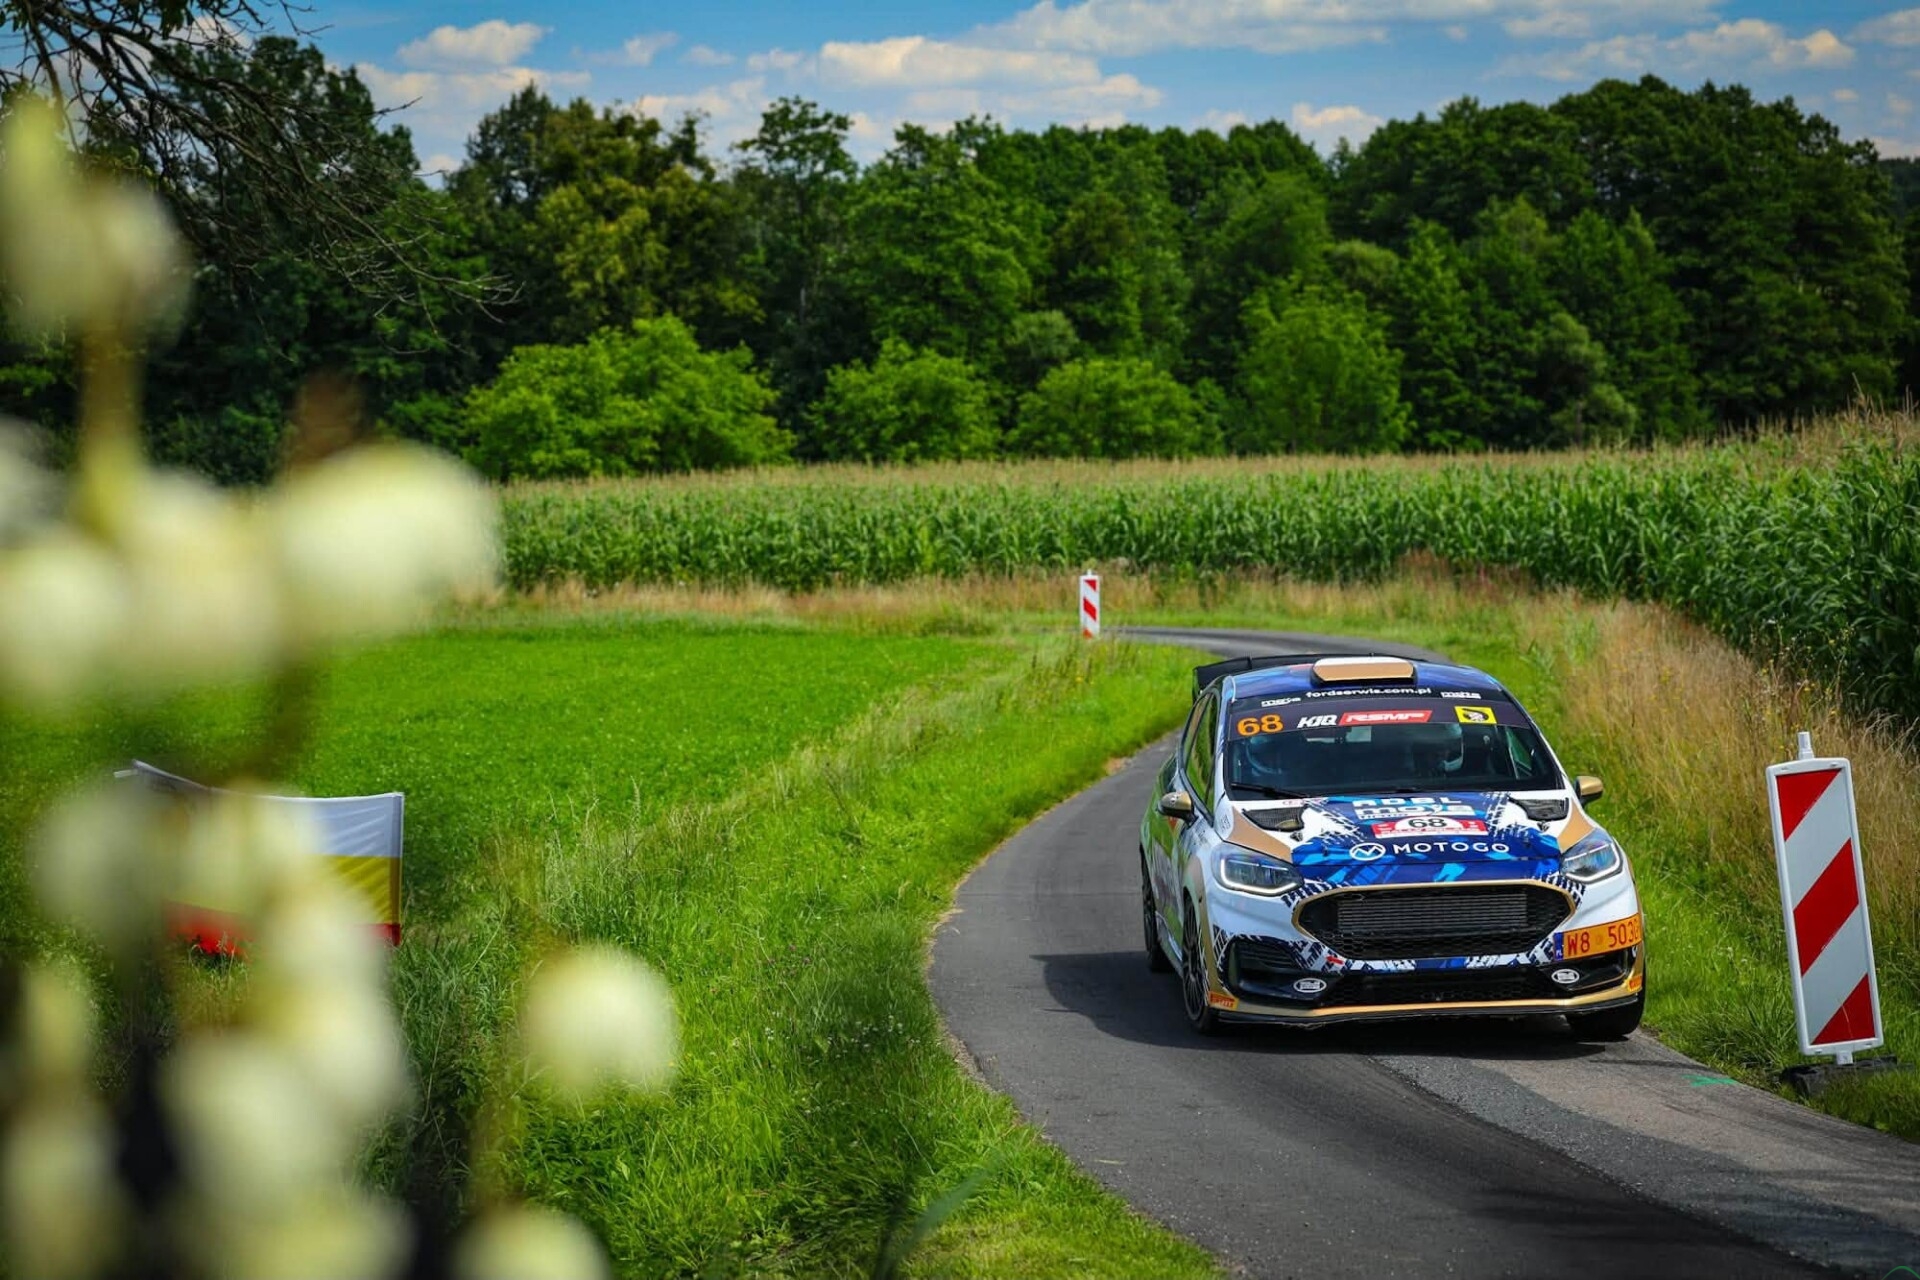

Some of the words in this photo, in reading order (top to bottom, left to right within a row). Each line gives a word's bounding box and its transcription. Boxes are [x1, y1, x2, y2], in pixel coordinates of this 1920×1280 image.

[1305, 687, 1432, 698] fordserwis.com.pl
[1237, 714, 1284, 736] 68
[1345, 712, 1425, 722] RSMP
[1407, 817, 1448, 829] 68
[1393, 841, 1510, 854] MOTOGO
[1567, 931, 1590, 957] W8
